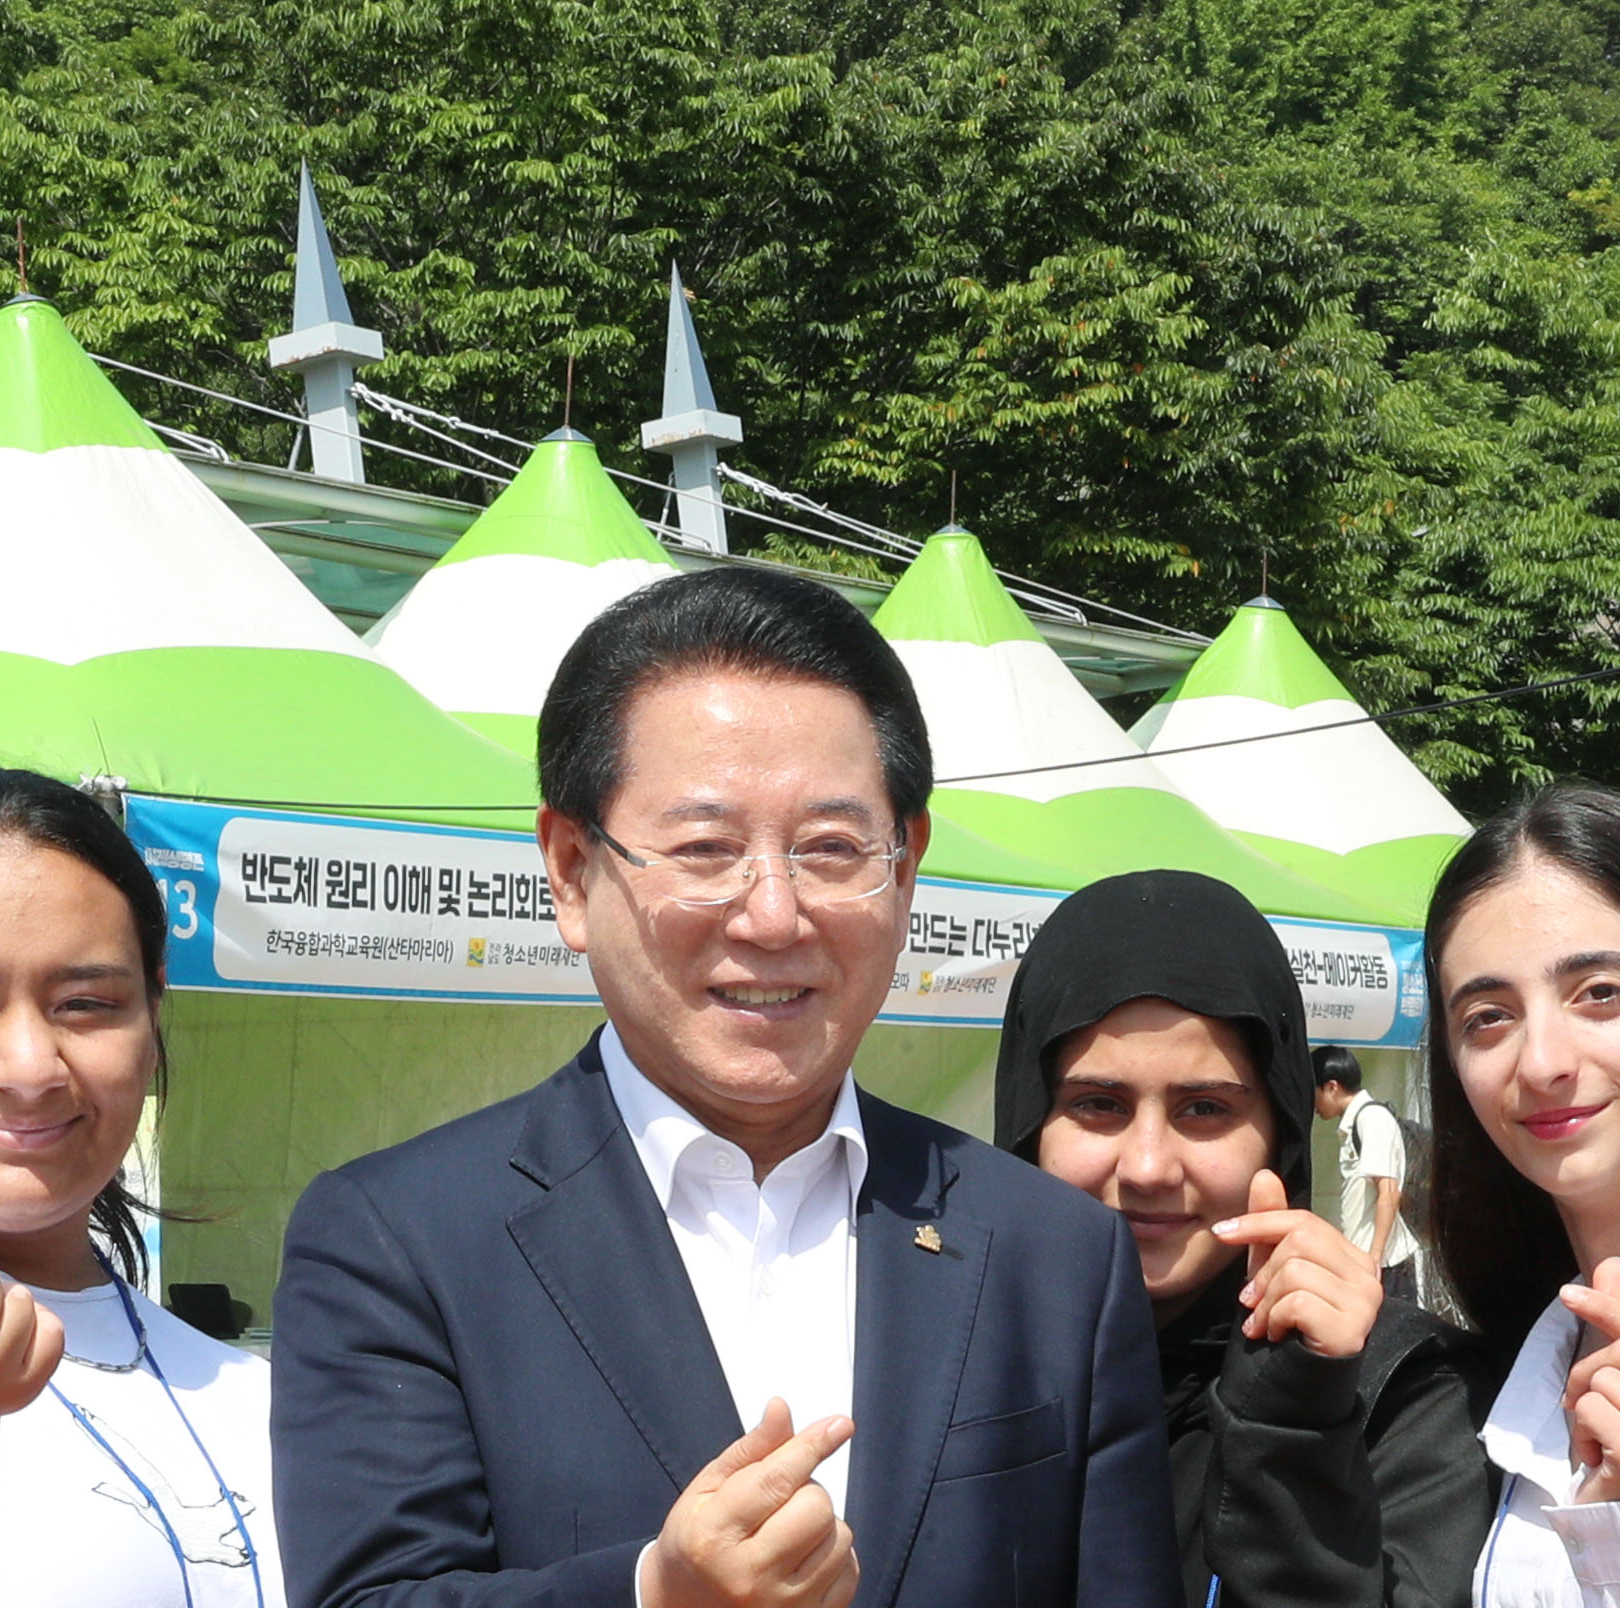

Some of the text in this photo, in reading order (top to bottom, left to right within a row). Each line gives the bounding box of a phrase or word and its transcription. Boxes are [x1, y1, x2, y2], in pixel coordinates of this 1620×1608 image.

[241, 852, 319, 908] 반도체
[325, 859, 376, 911] 원리
[383, 863, 432, 915] 이해
[437, 868, 461, 917] 및
[266, 928, 454, 964] 한국융합과학교육원(산타마리아)
[502, 943, 580, 968] 청소년미래재단
